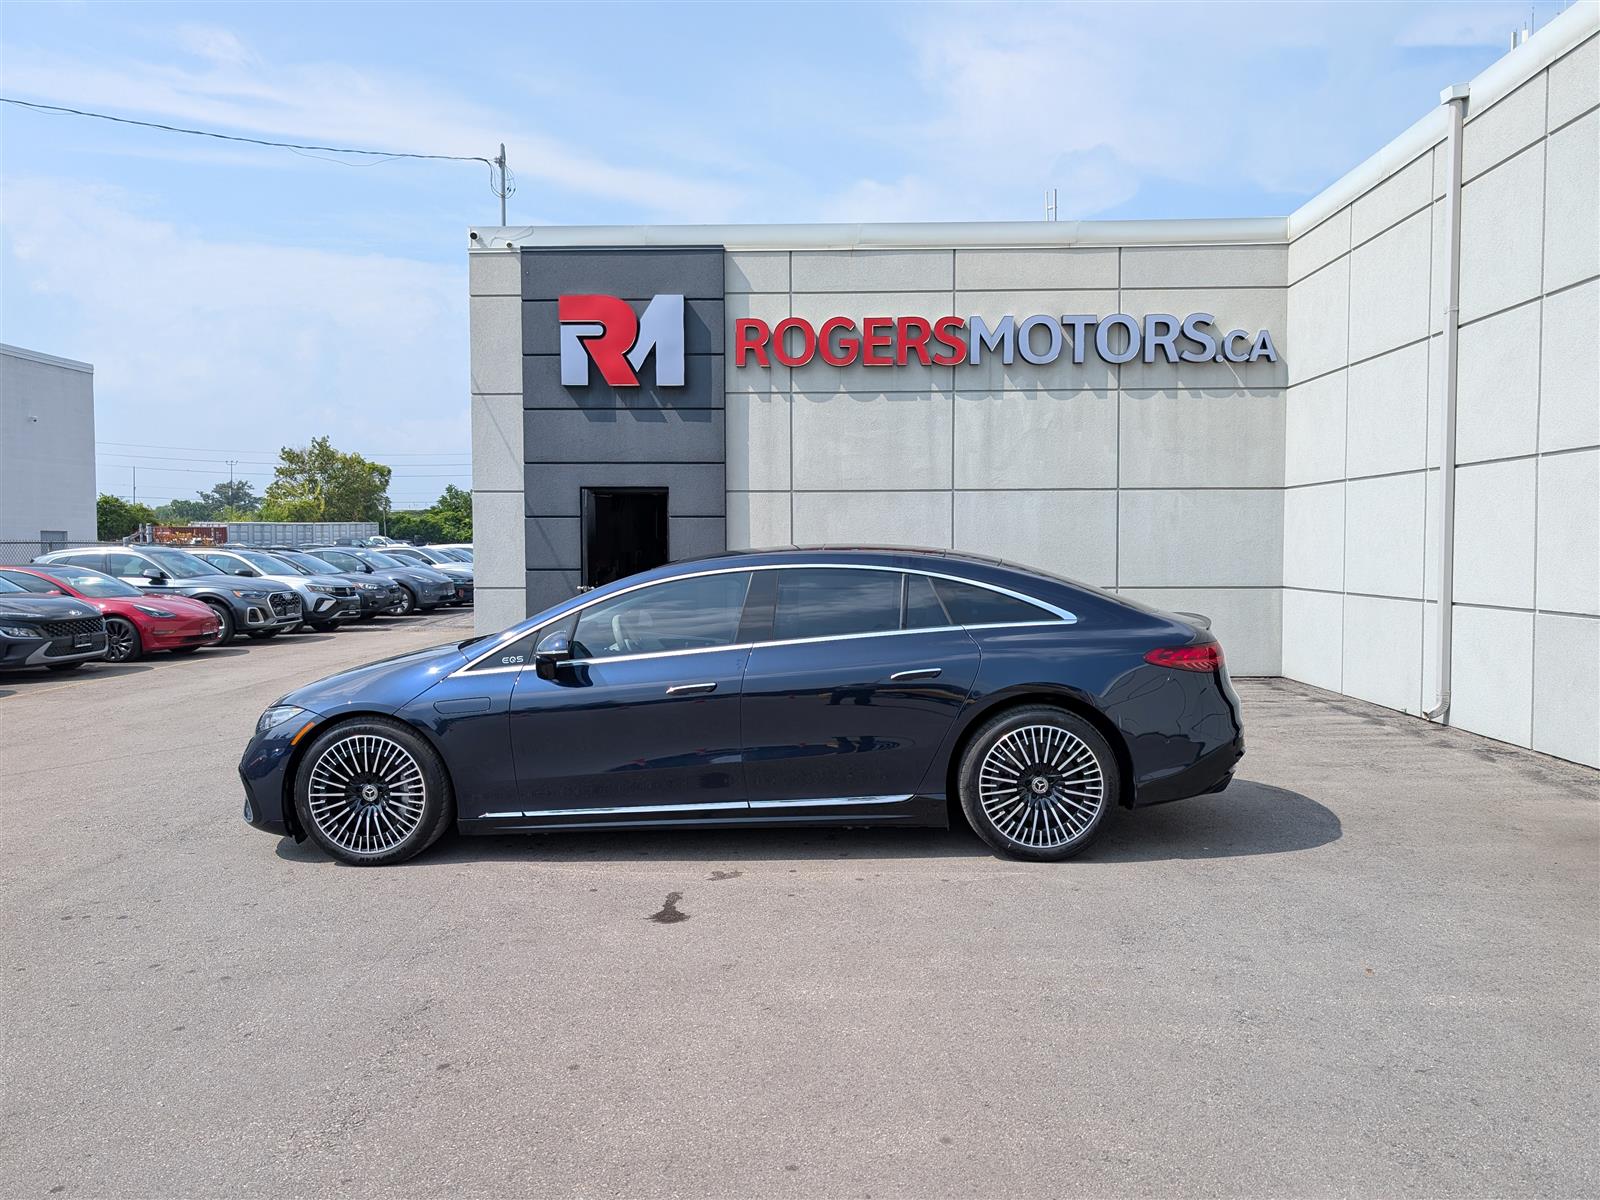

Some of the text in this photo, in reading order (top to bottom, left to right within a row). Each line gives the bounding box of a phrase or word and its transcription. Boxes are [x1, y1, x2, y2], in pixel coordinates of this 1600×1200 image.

[558, 293, 685, 387] RM
[735, 313, 1278, 368] ROGERSMOTORS.CA
[501, 655, 524, 664] EQS
